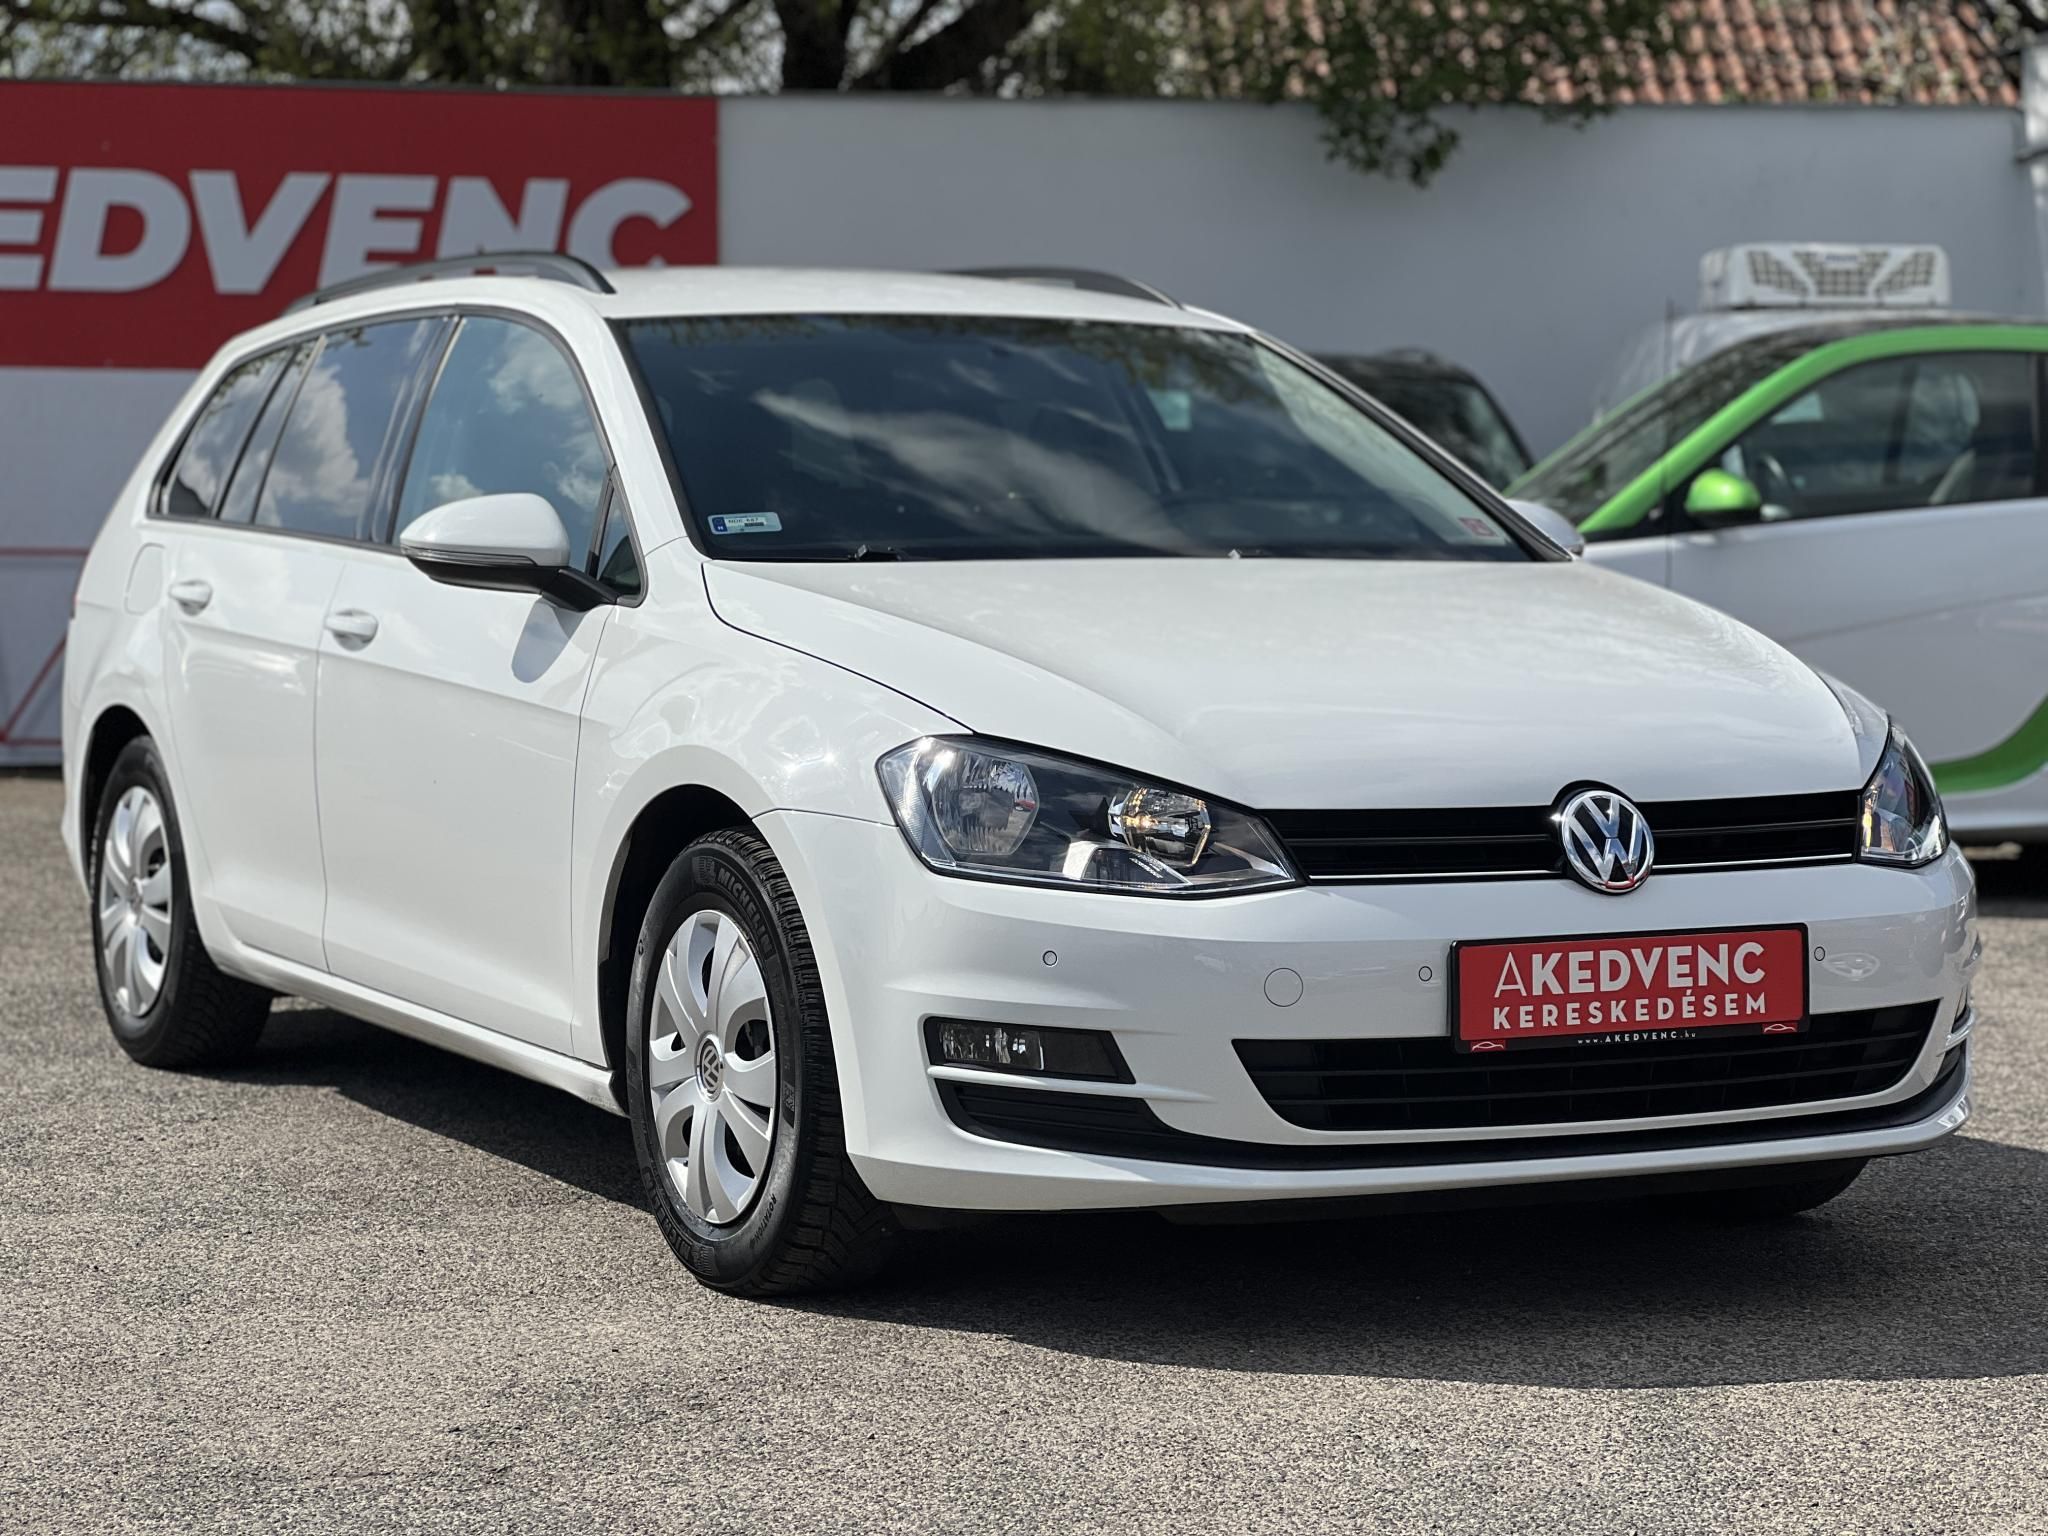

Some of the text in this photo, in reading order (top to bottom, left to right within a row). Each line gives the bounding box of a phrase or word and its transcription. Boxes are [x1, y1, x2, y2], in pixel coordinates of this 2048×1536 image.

[718, 867, 773, 954] MICHELIN
[1494, 942, 1766, 998] AKEDVENC
[1493, 989, 1767, 1030] KERESKEDÉSEM
[1577, 1030, 1697, 1044] www.AKEDVENC.hu
